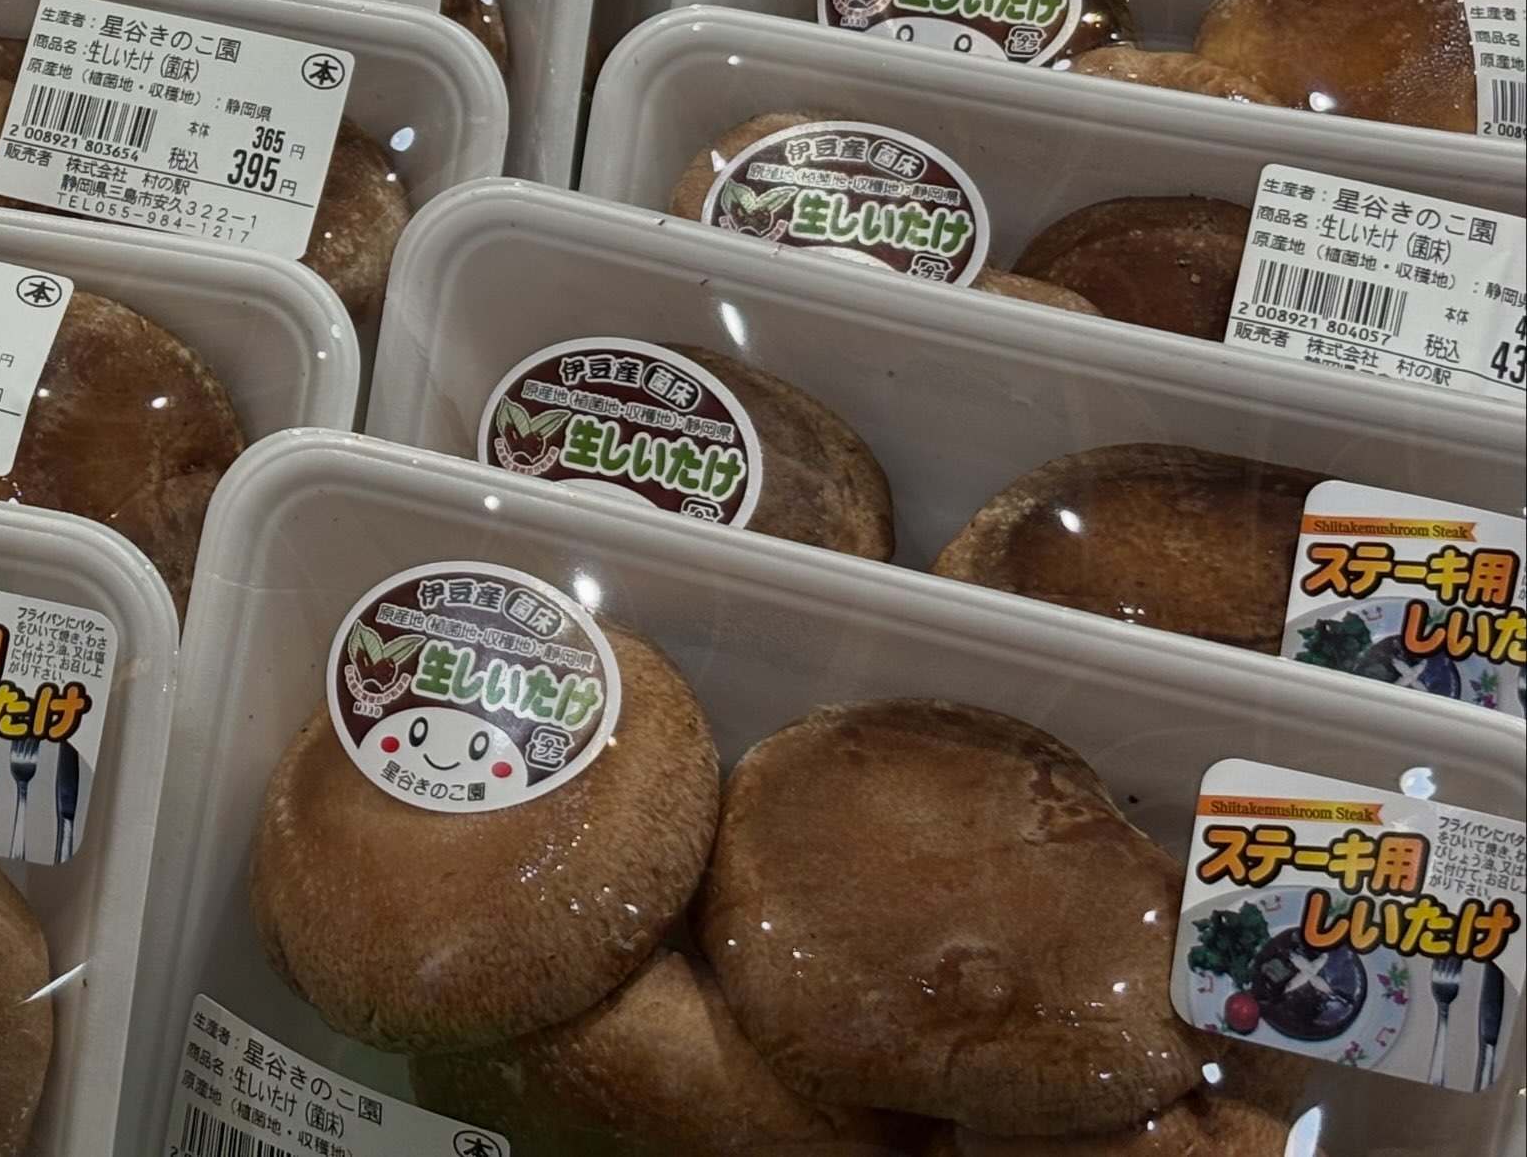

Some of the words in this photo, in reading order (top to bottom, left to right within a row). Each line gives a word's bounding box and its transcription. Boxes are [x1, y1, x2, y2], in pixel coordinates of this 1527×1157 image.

[23, 129, 78, 149] 008921
[84, 141, 139, 161] 803654
[786, 137, 868, 164] 伊豆産
[789, 188, 973, 257] 生しいたけ
[1255, 305, 1318, 329] 008921
[1326, 321, 1392, 346] 804057
[560, 356, 642, 385] 伊豆産
[648, 368, 697, 407] 菌床
[560, 415, 746, 501] 生しいたけ
[1314, 520, 1429, 537] Shiitakemushroom
[1432, 524, 1467, 538] Steak
[1300, 541, 1520, 610] ステーキ用
[420, 580, 504, 612] 伊豆産
[510, 595, 557, 633] 菌床
[1402, 598, 1526, 665] しいた
[412, 641, 603, 729] 生しいたけ
[381, 761, 486, 801] 星谷きのこ園
[1211, 801, 1332, 820] Shiitakemushroom
[1336, 807, 1373, 822] Steak
[1196, 824, 1430, 898] ステーキ用
[1301, 890, 1520, 962] しいたけ
